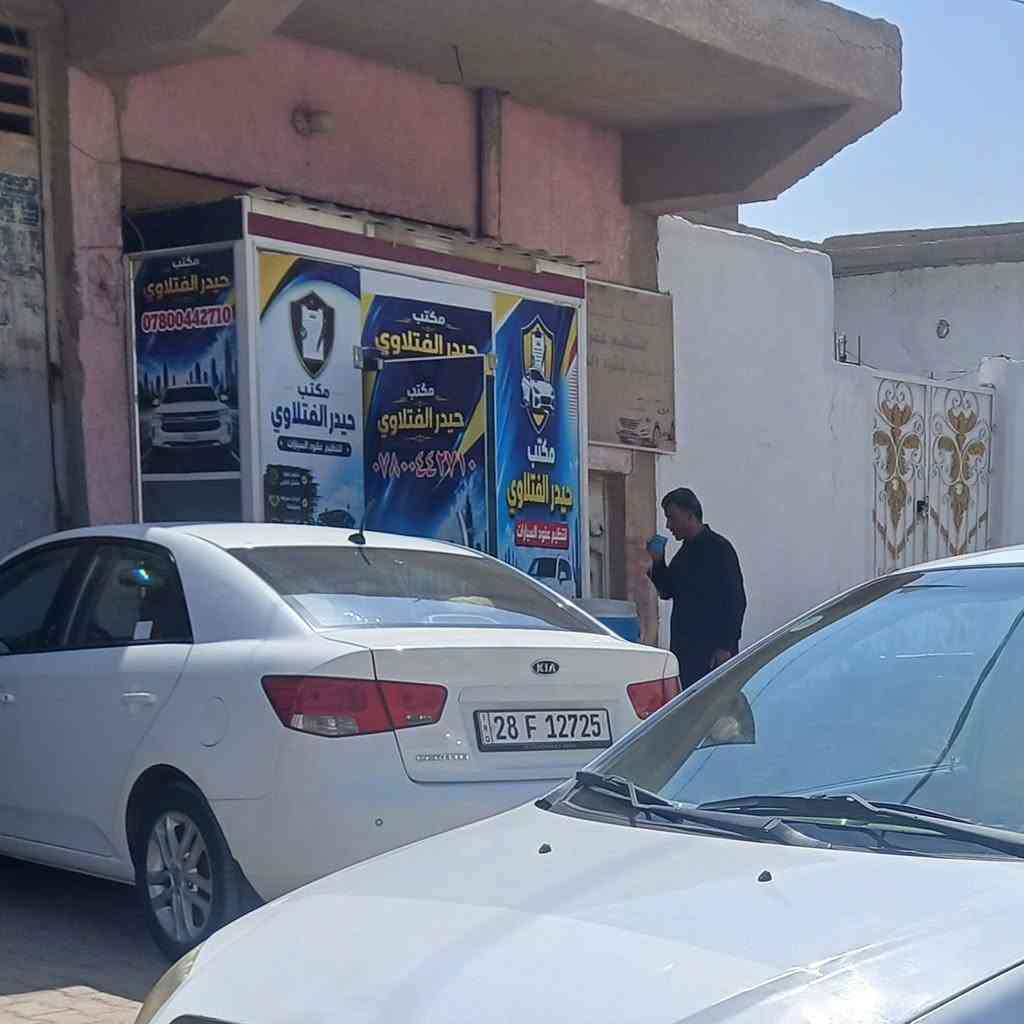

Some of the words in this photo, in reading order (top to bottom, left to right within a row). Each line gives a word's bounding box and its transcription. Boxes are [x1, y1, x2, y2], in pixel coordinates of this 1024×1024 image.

[171, 256, 200, 270] مكتب
[200, 274, 232, 294] حيدر
[142, 304, 233, 333] 07800442710
[412, 309, 446, 325] مكتب
[375, 330, 443, 356] الفتلاوي
[297, 382, 330, 400] مكتب
[406, 382, 435, 401] مكتب
[271, 401, 328, 434] الفتلاوي
[328, 411, 356, 436] حيدر
[377, 406, 433, 438] الفتلاوي
[433, 411, 465, 434] حيدر
[527, 437, 556, 469] مكتب
[507, 472, 549, 514] الفتلاوي
[550, 483, 574, 514] حيدر
[494, 715, 519, 740] 28
[526, 715, 537, 739] F
[545, 713, 601, 739] 12725
